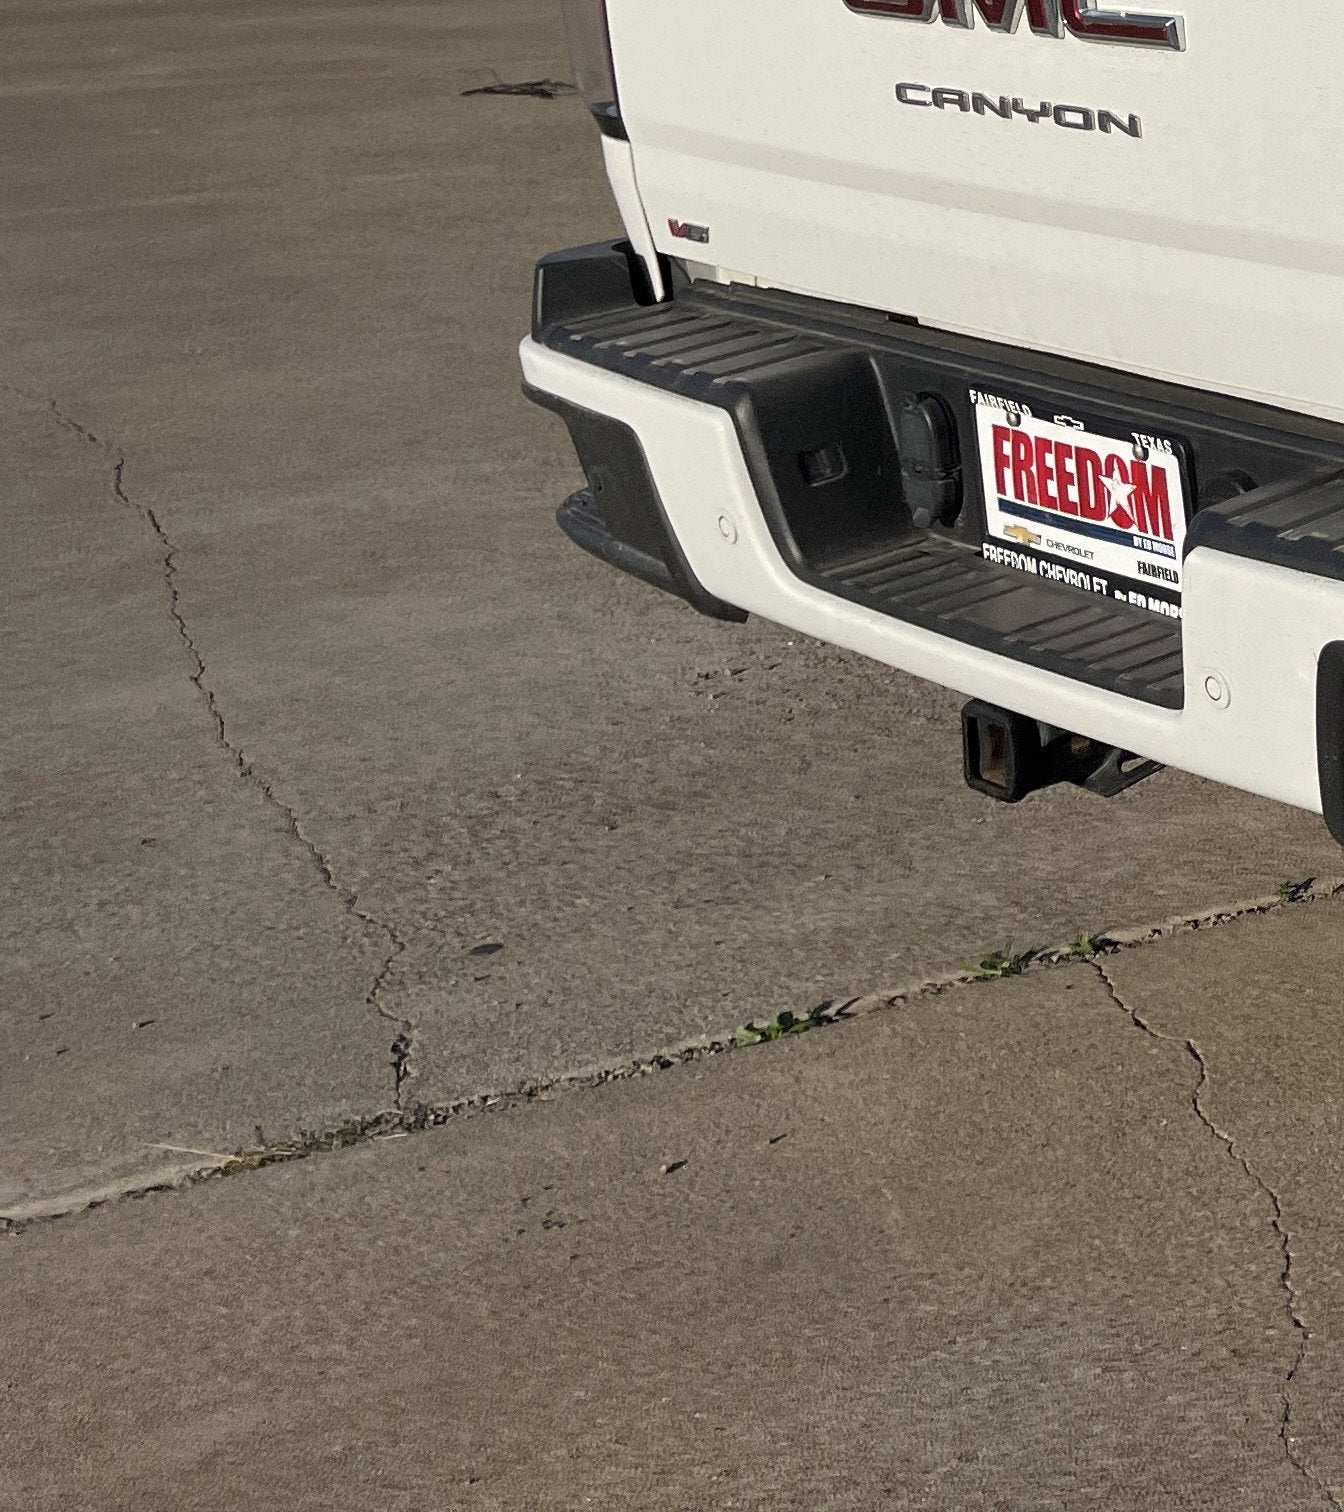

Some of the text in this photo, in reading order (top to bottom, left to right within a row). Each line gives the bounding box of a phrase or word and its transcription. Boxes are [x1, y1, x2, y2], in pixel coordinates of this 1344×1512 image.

[895, 82, 1143, 139] CANYON
[969, 389, 1032, 417] FAIRFIELD
[1131, 432, 1173, 455] TEXAS
[992, 424, 1174, 541] FREEDOM
[1046, 538, 1095, 561] CHEVROLET
[983, 542, 1037, 575] FREEDOM
[1039, 559, 1108, 596] CHEVROLET
[1137, 560, 1179, 584] FAIRFIELD
